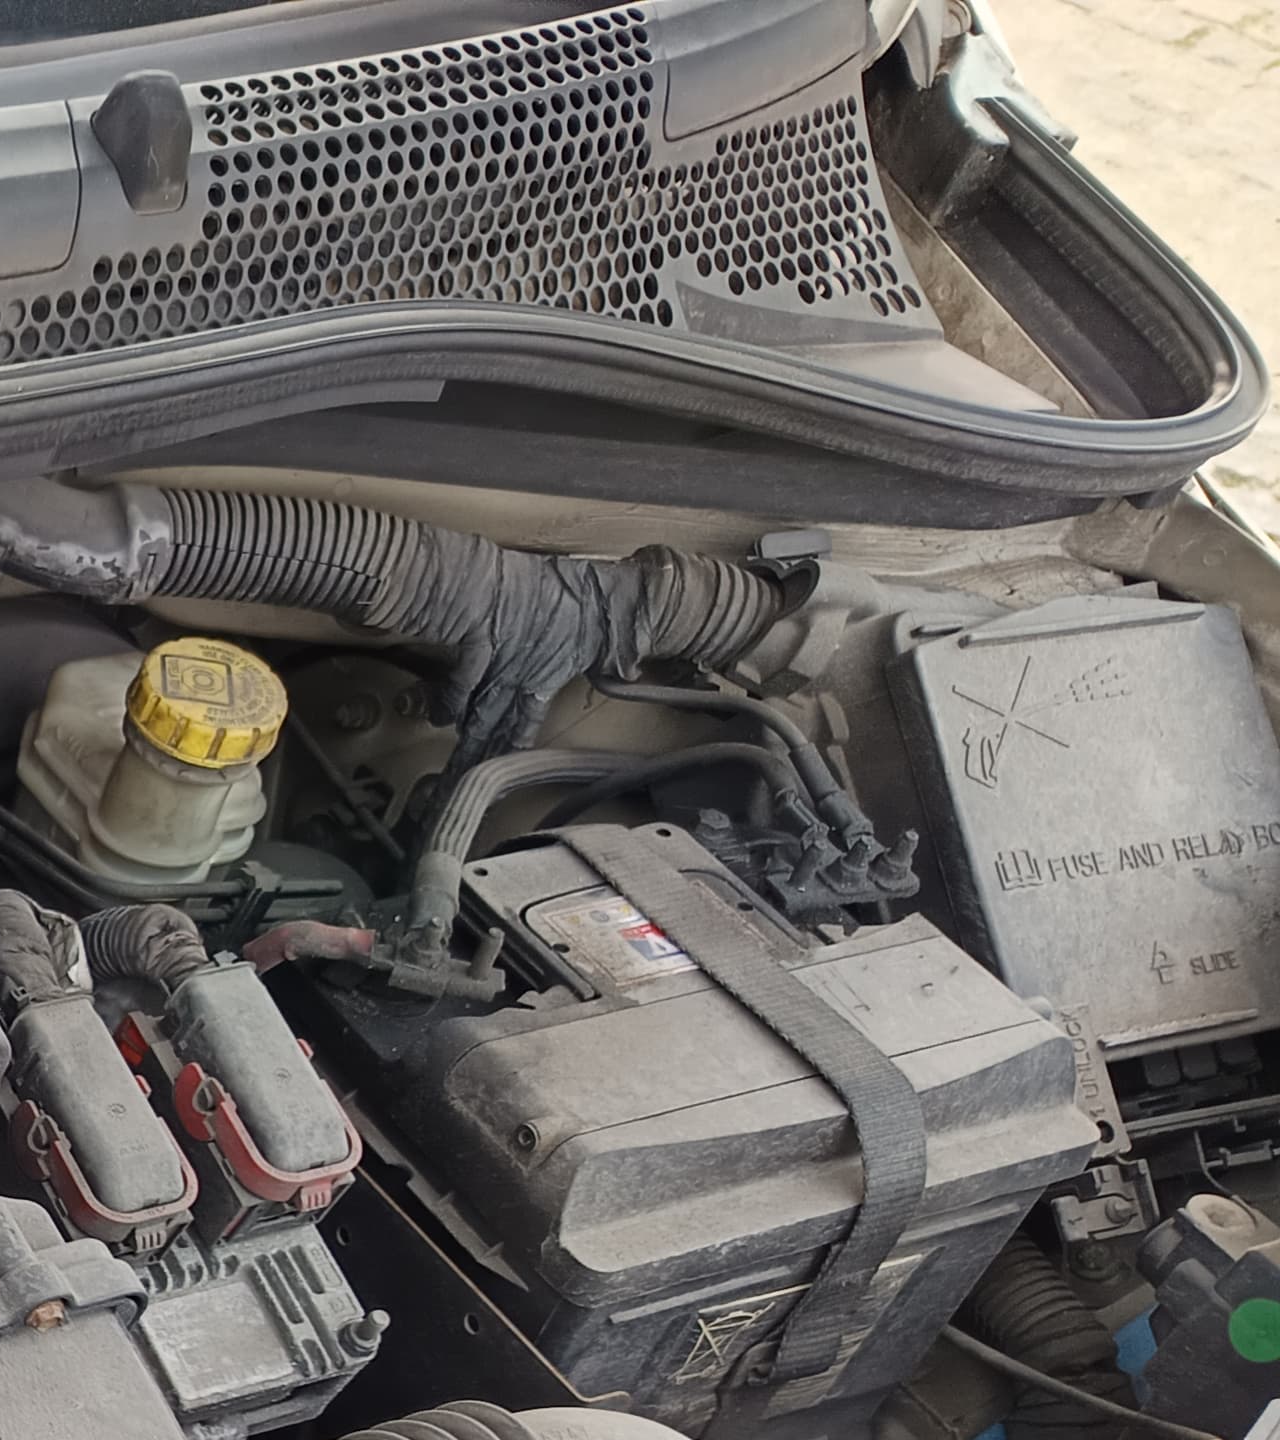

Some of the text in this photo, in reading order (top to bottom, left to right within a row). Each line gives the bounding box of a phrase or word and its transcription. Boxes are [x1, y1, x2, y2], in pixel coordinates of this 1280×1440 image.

[1048, 850, 1109, 882] FUSE
[1119, 841, 1164, 872] AND
[1171, 828, 1245, 862] RELAY
[1189, 950, 1240, 976] SLIDE
[1060, 1011, 1099, 1100] UNLOCK
